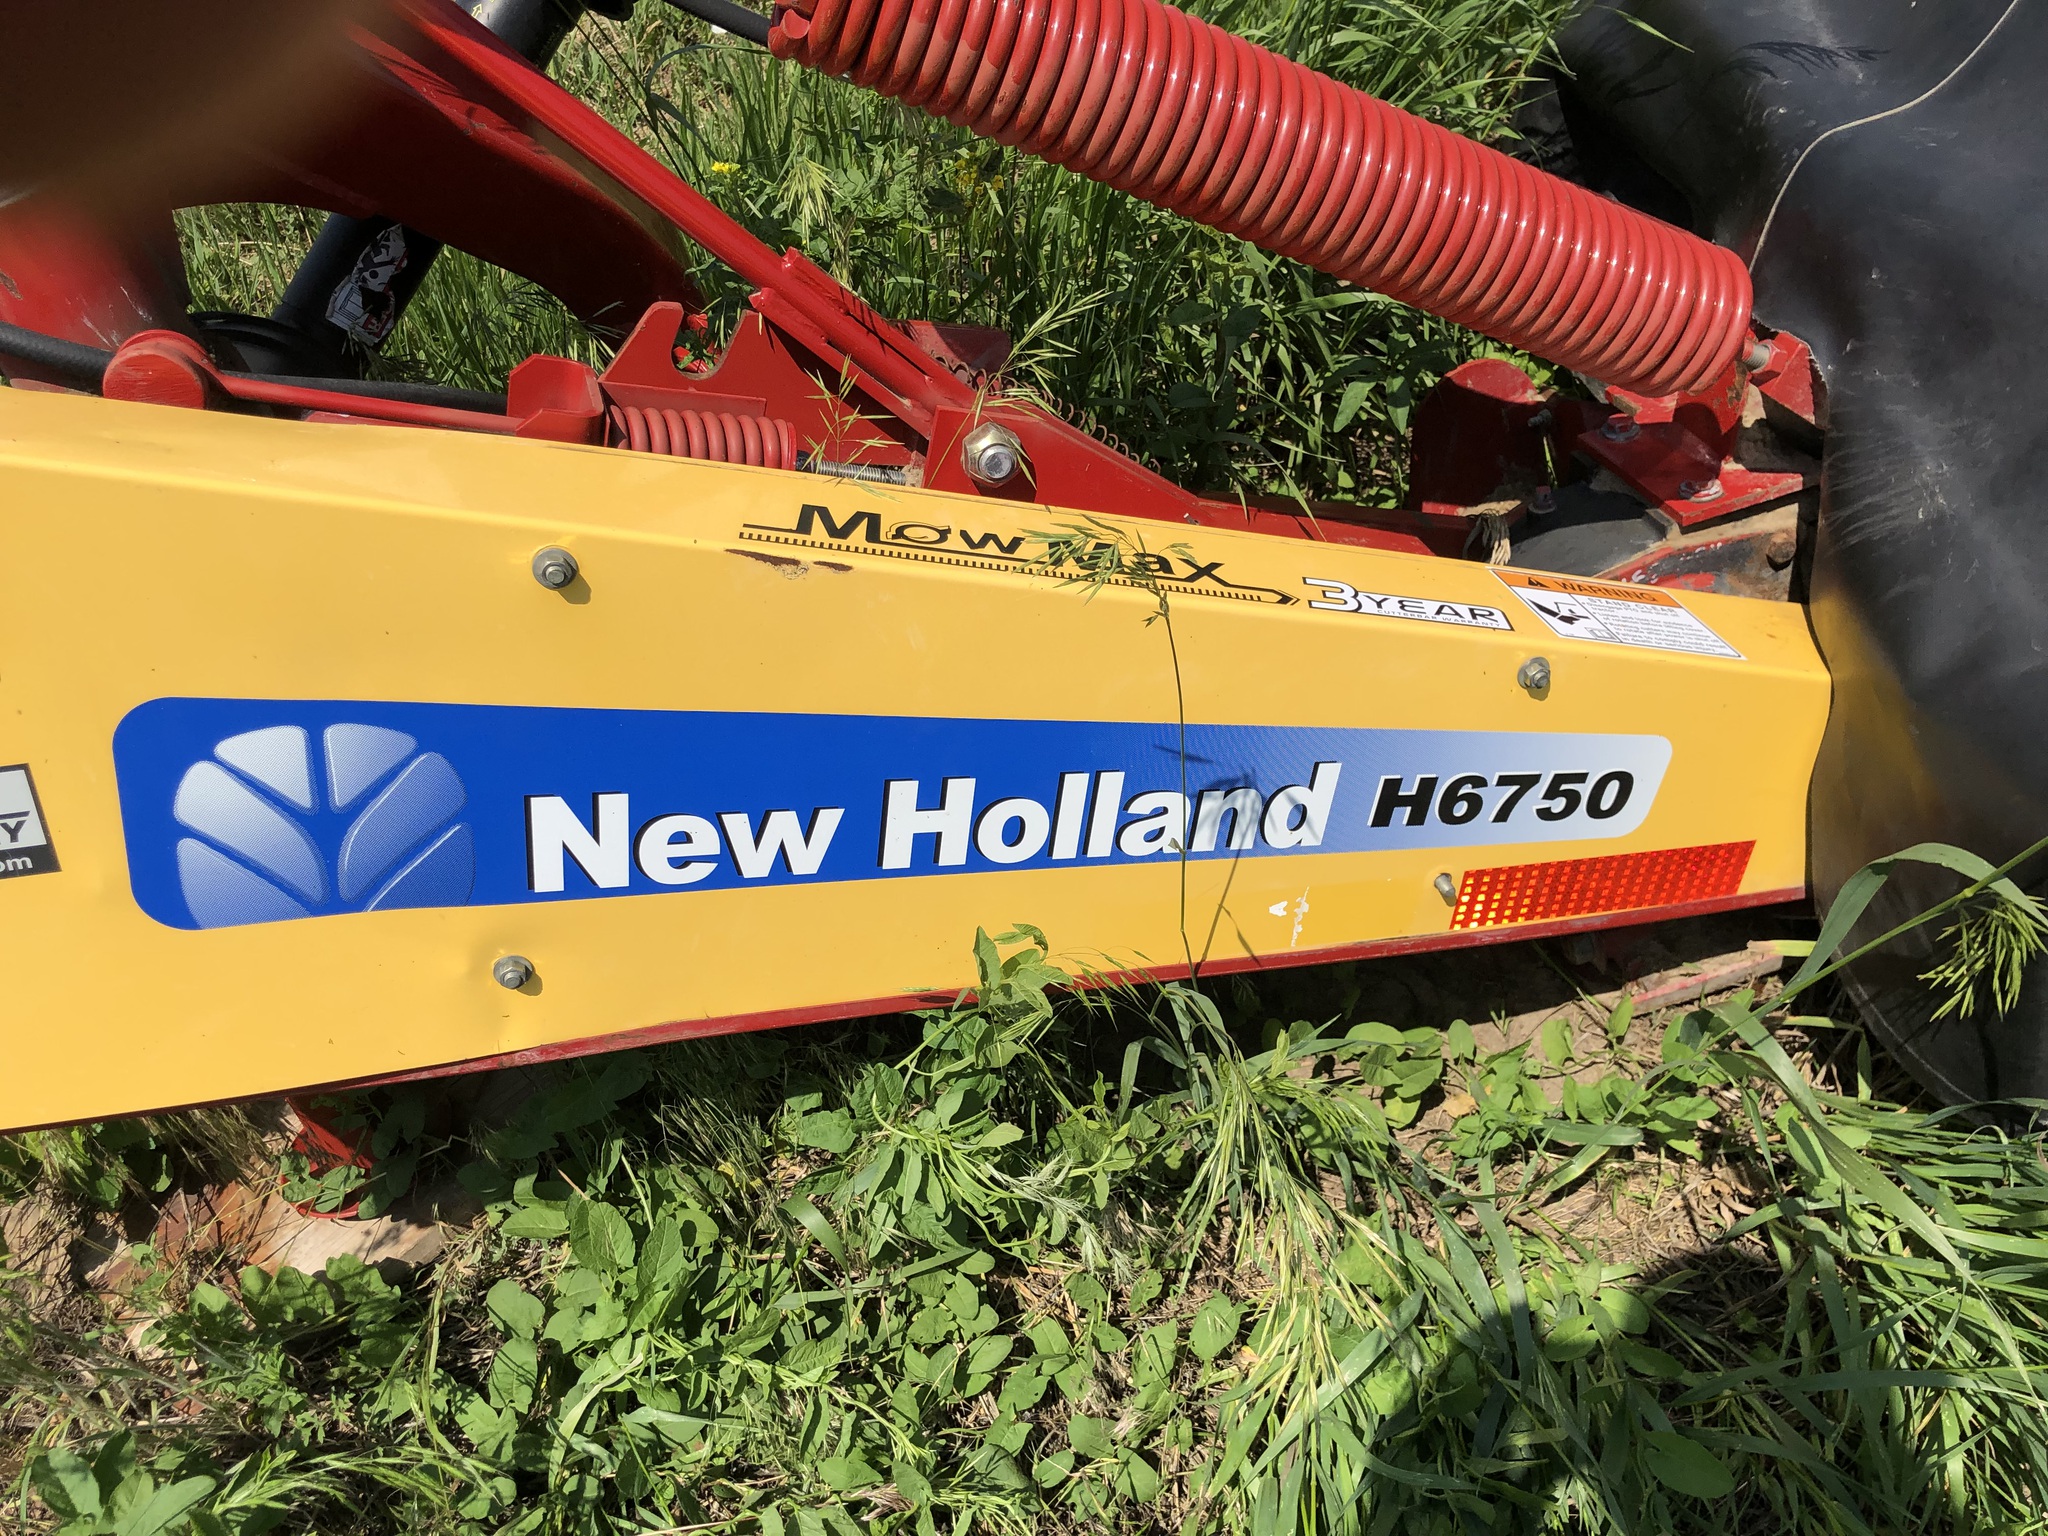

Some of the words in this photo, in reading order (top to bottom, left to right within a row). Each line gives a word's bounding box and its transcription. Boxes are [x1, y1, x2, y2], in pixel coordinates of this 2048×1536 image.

[797, 504, 1026, 554] Mow
[1302, 577, 1361, 613] 3
[1363, 595, 1499, 622] YEAR
[1552, 580, 1658, 602] WARNING
[1377, 609, 1438, 620] CUTTERBAR
[1441, 617, 1500, 627] WARRANTY
[1368, 770, 1634, 827] H6750
[525, 792, 845, 892] New
[877, 761, 1342, 870] Holland
